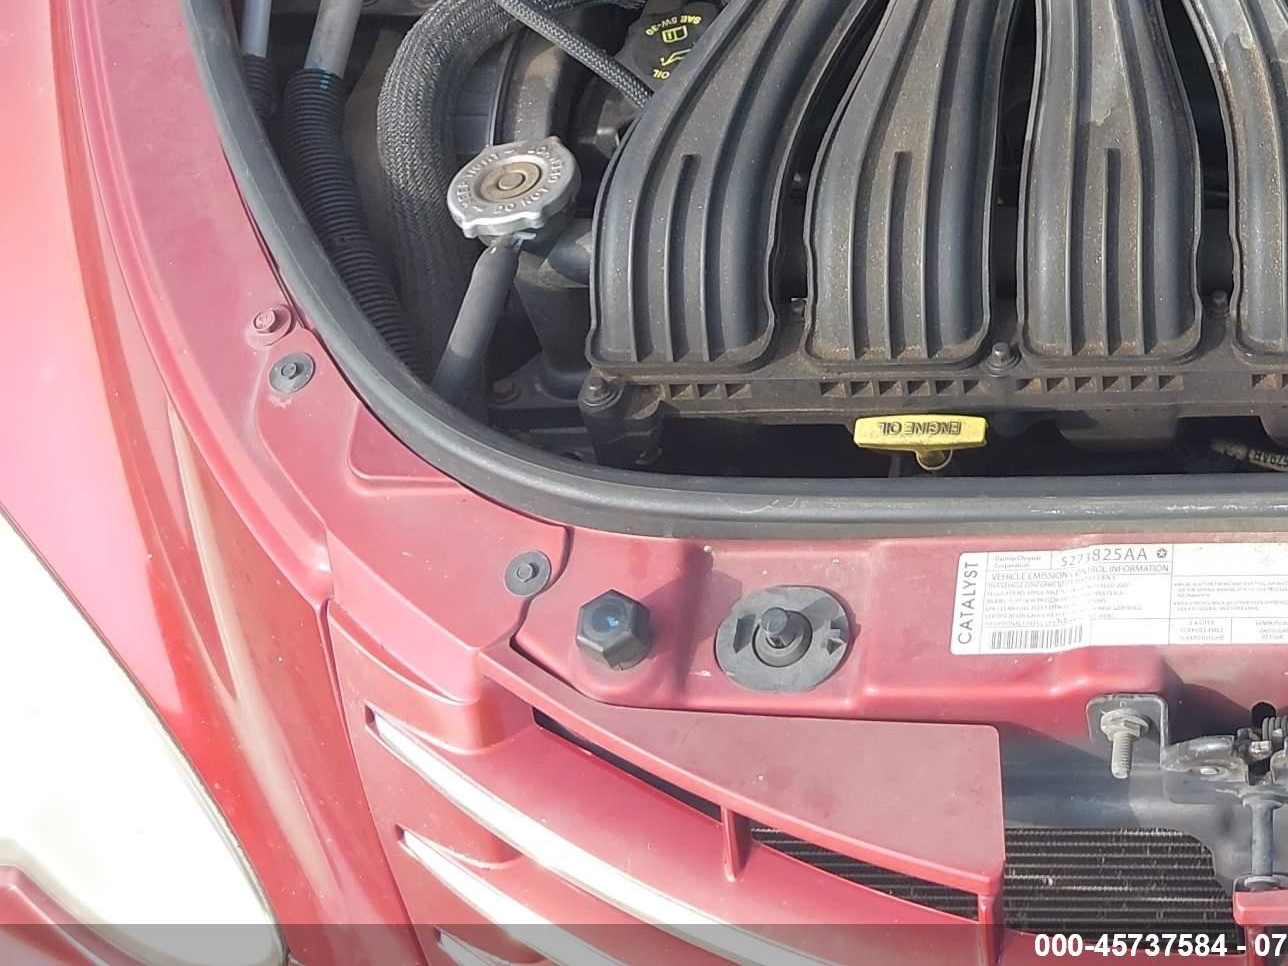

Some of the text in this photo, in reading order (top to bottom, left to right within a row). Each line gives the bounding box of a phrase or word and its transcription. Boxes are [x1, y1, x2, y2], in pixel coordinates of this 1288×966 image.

[680, 15, 702, 25] SAE
[652, 69, 671, 79] OIL
[879, 421, 962, 435] ENGINE OIL
[1061, 547, 1148, 567] 5273825AA
[992, 572, 1026, 581] VEHICLE
[1027, 571, 1068, 580] EMISSION
[1109, 564, 1169, 573] INFORMATION
[957, 561, 979, 645] CATALYST
